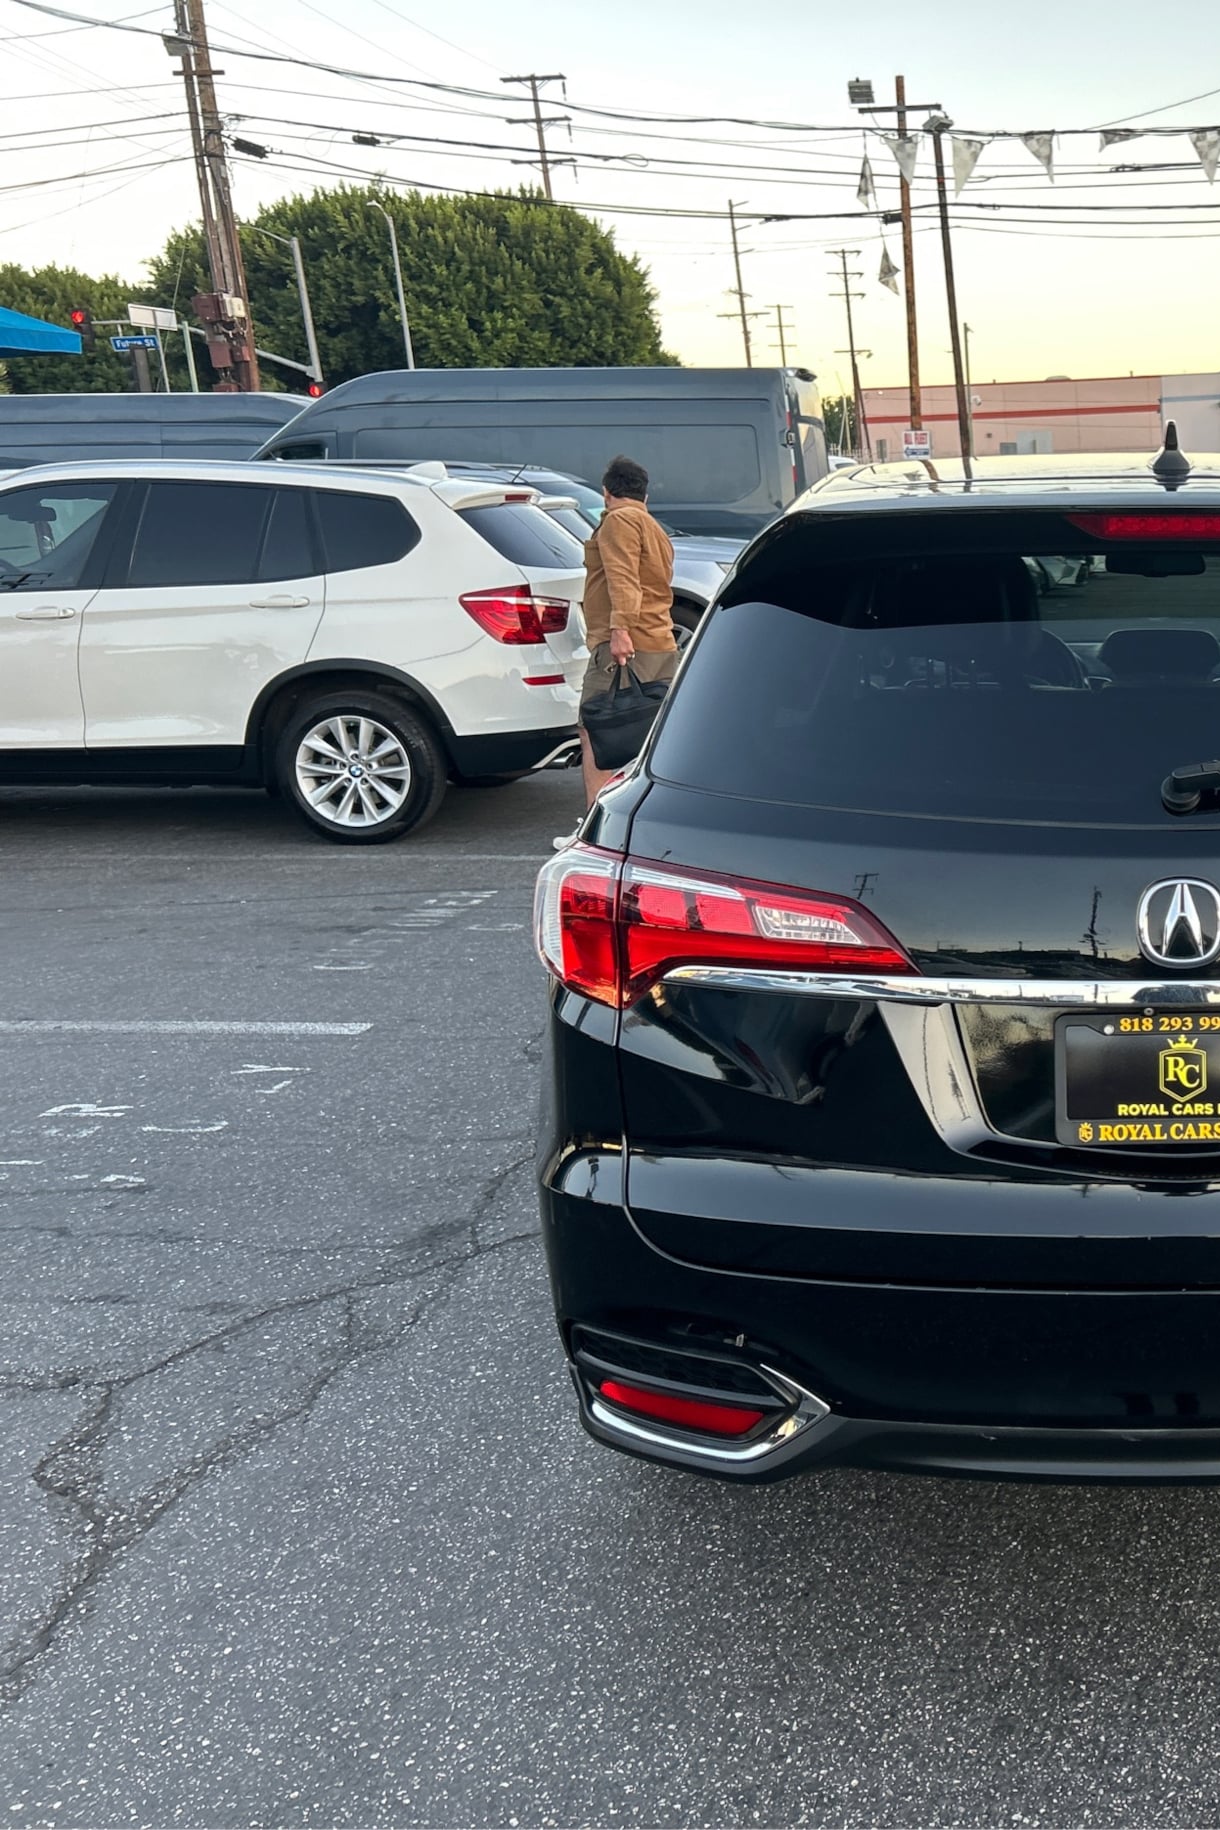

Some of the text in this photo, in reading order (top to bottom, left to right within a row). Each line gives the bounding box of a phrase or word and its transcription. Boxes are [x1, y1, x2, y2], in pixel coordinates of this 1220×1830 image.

[144, 338, 155, 346] St
[1119, 1017, 1154, 1032] 818
[1158, 1016, 1194, 1031] 293
[1165, 1055, 1201, 1089] RC
[1117, 1103, 1170, 1117] ROYAL
[1172, 1102, 1214, 1116] CARS
[1098, 1123, 1168, 1142] ROYAL
